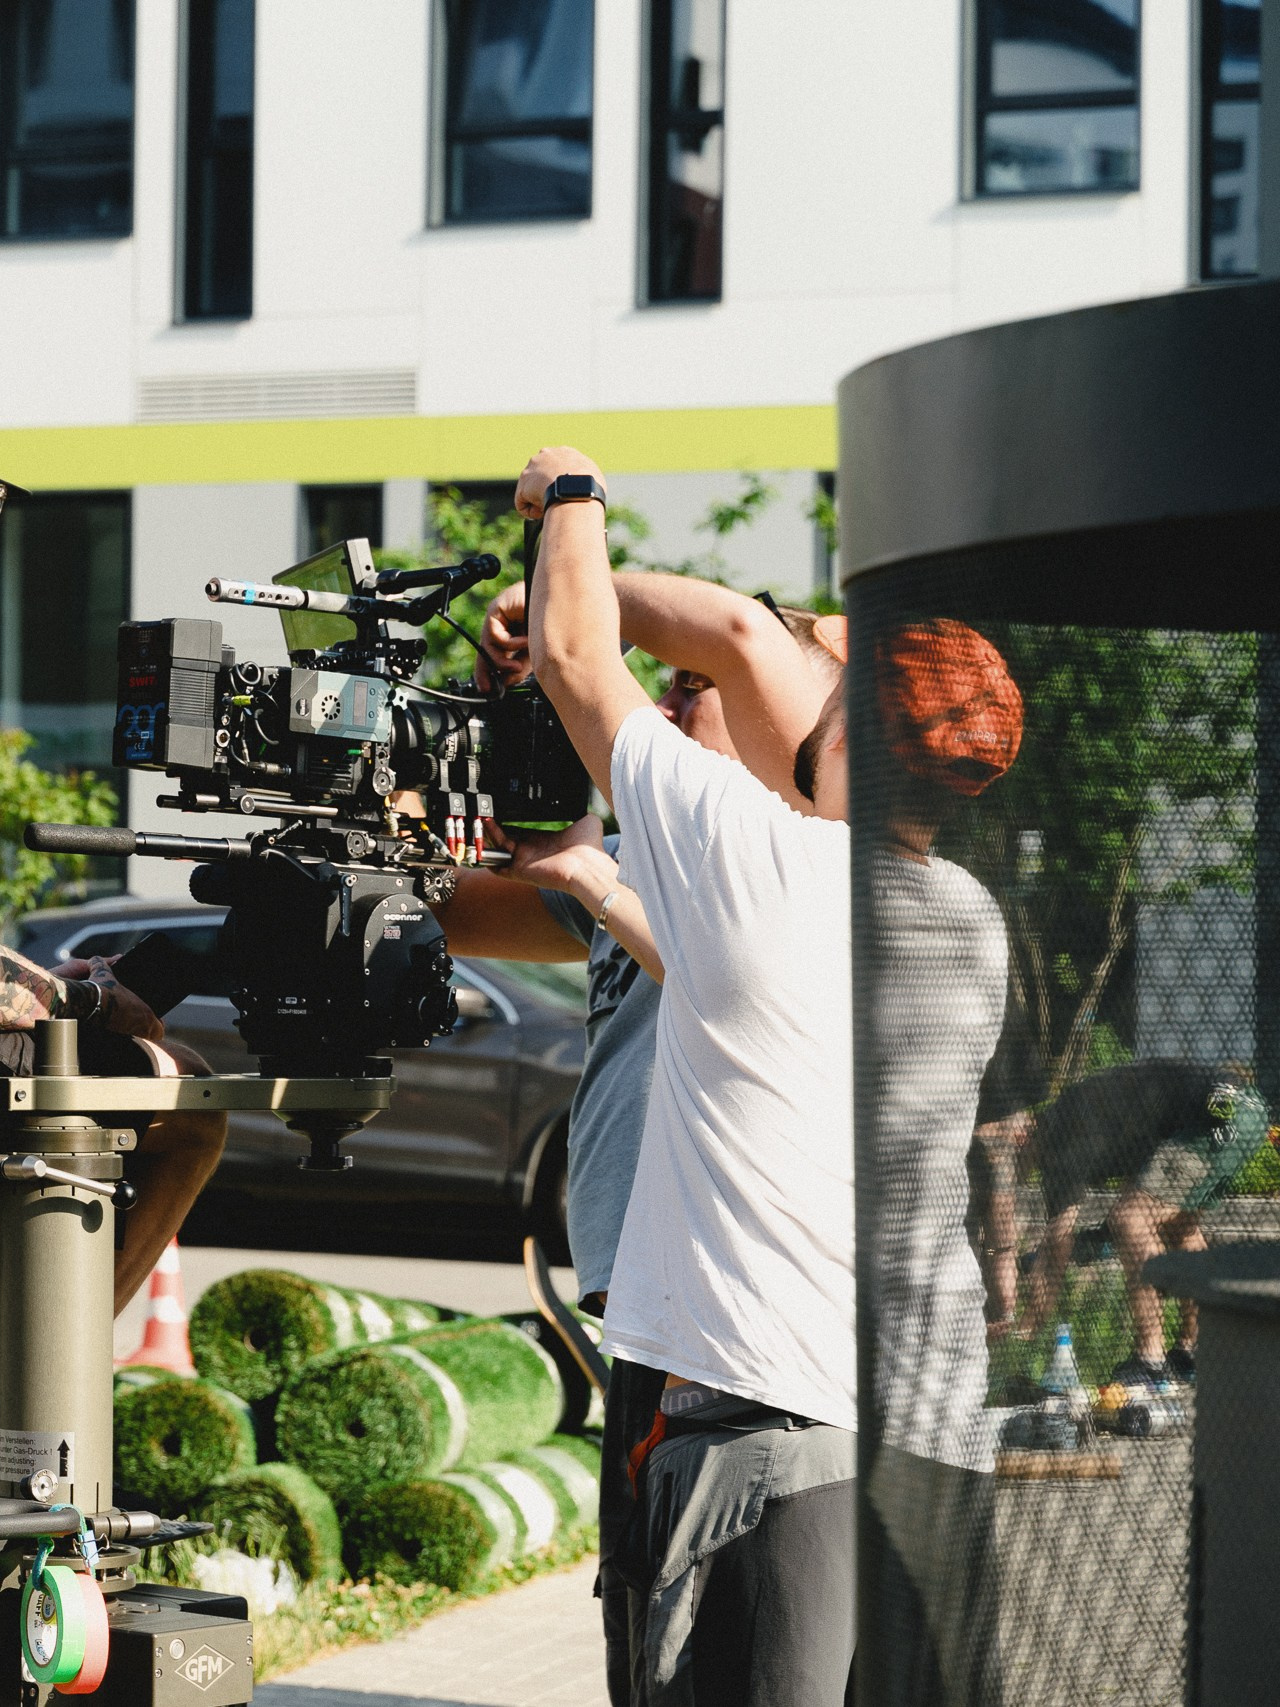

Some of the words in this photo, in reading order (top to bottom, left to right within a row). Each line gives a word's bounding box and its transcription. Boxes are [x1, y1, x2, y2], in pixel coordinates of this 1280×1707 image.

[5, 1436, 37, 1445] Verstellen:
[13, 1447, 49, 1456] Gas-Druck
[7, 1457, 37, 1466] adjusting:
[5, 1466, 31, 1475] pressure
[185, 1655, 223, 1684] GFM
